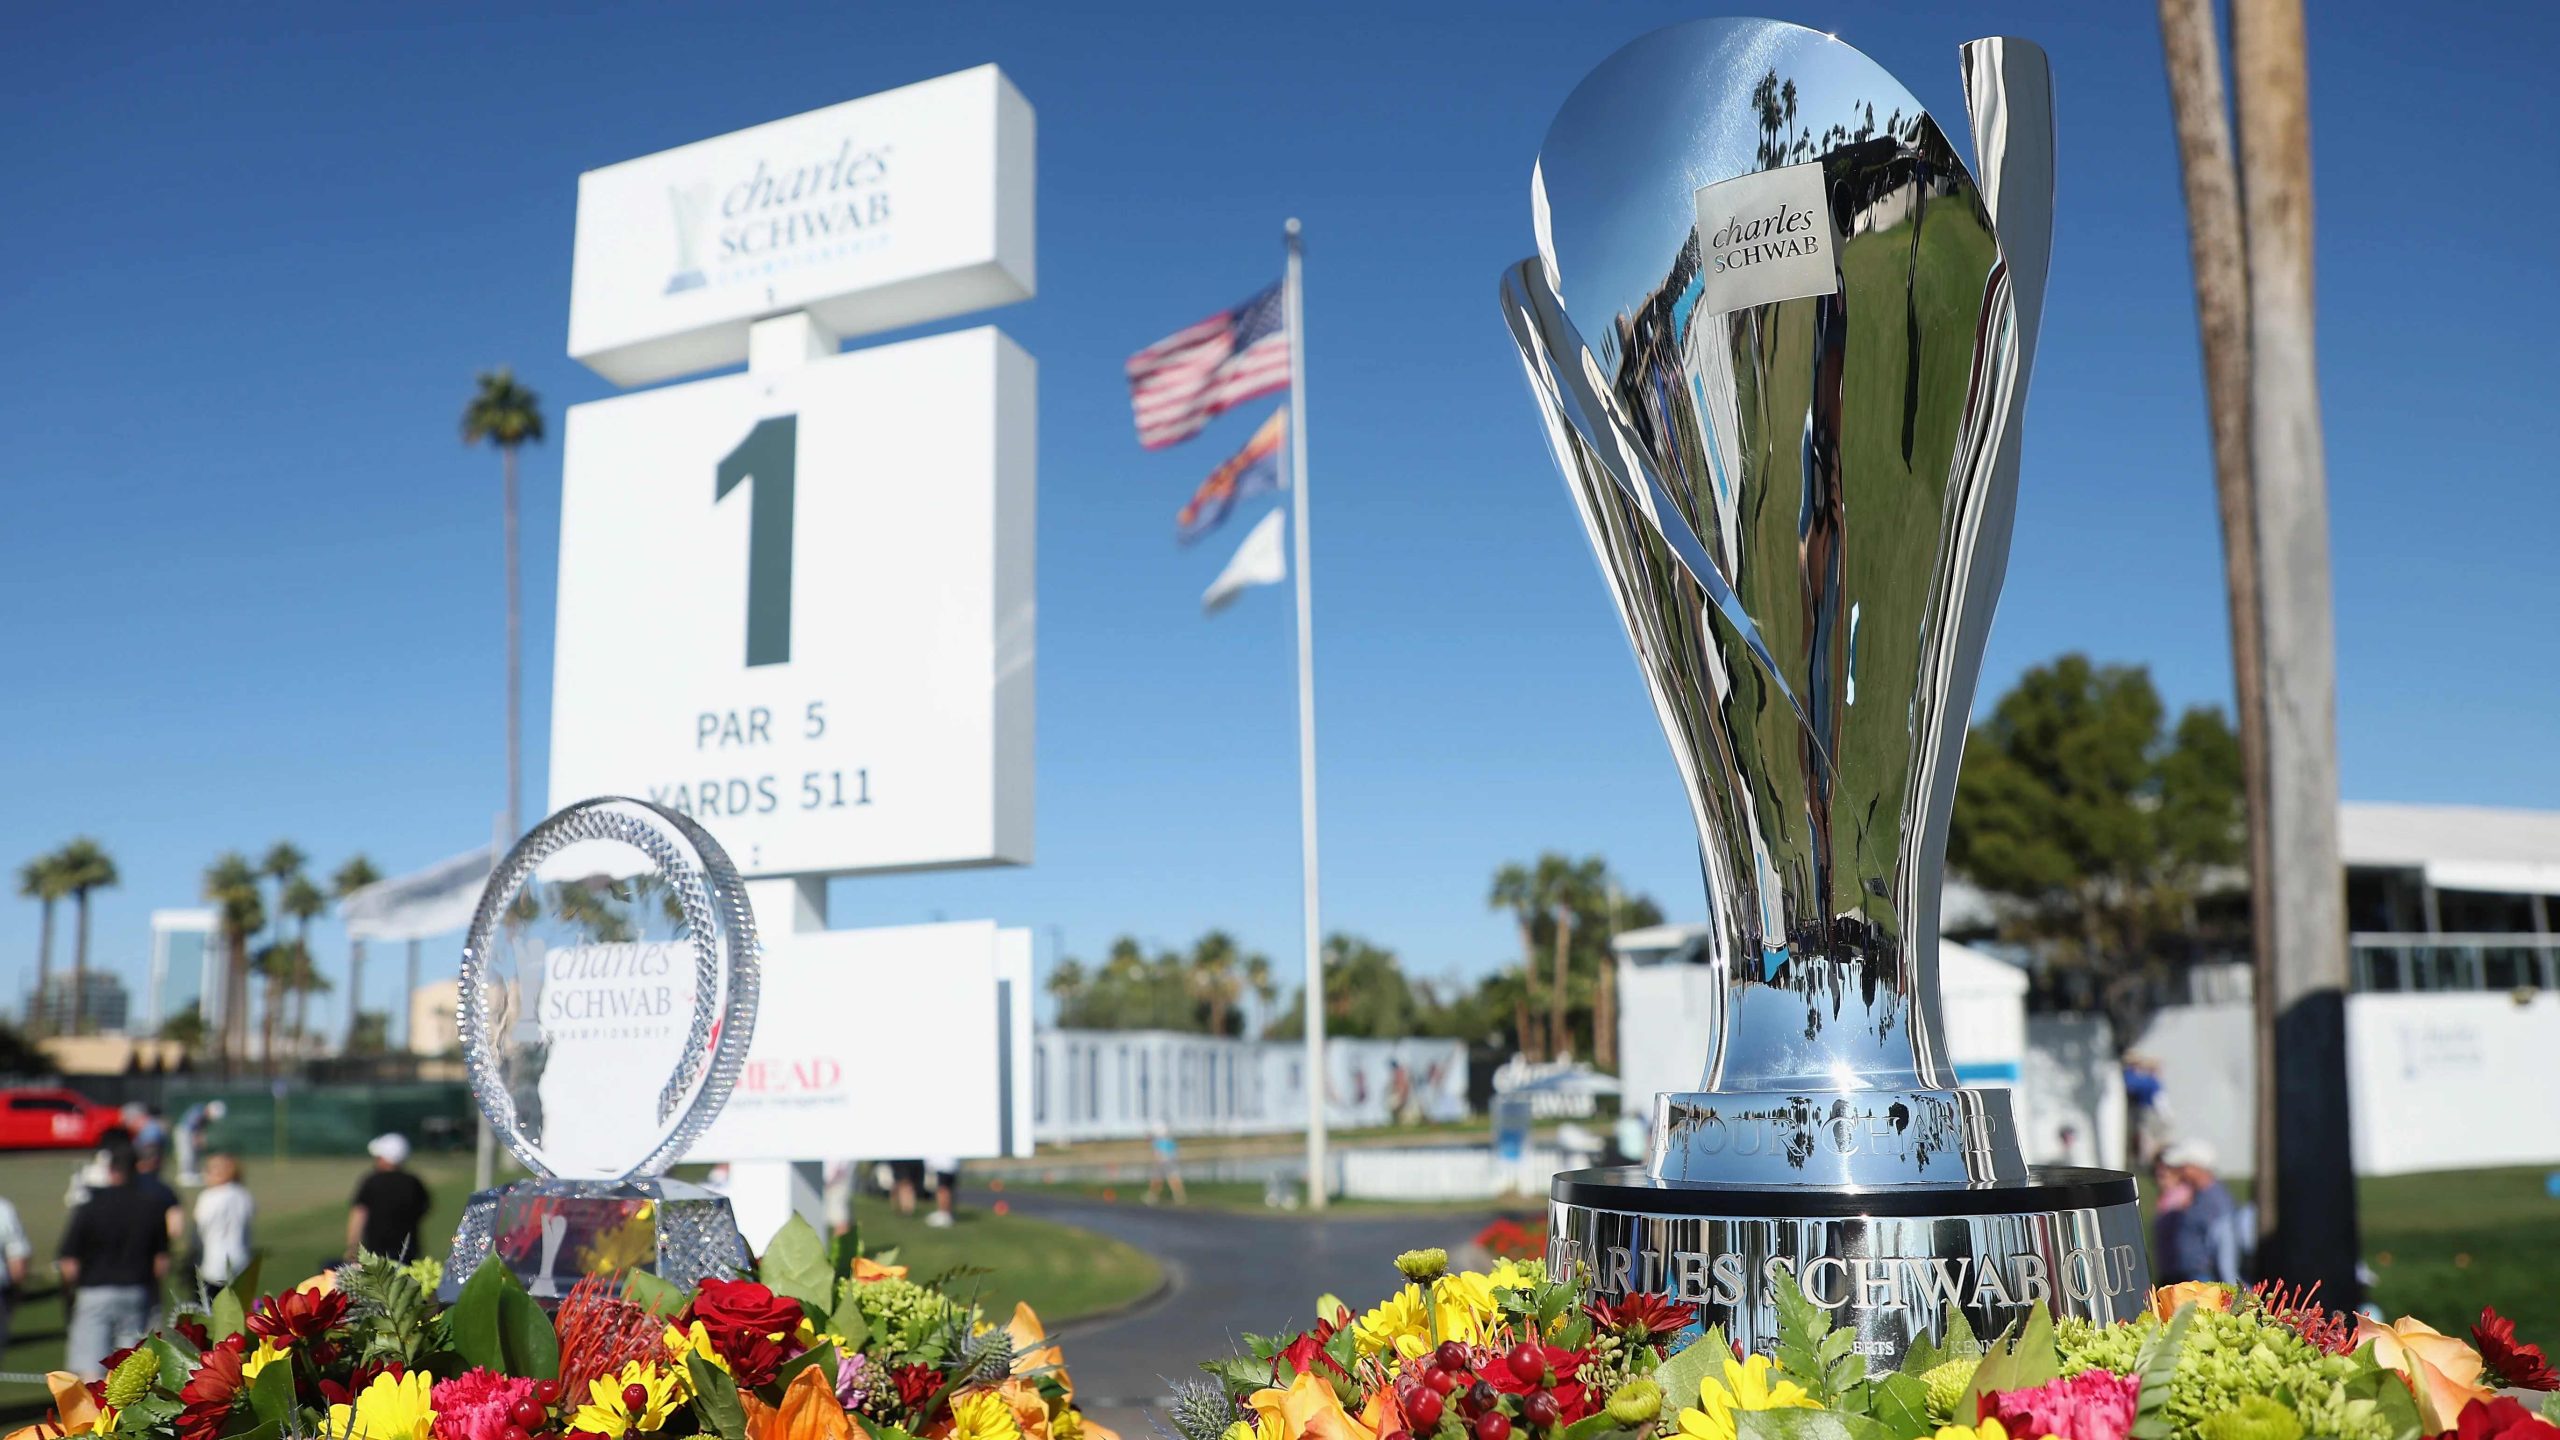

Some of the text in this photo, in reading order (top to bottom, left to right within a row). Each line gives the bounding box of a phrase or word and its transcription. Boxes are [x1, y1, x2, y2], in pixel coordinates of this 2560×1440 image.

[721, 137, 887, 220] charles
[718, 192, 891, 260] SCHWAB
[1713, 203, 1814, 249] charles
[1714, 236, 1819, 274] SCHWAB
[710, 412, 798, 669] 1
[696, 700, 826, 750] PAR 5
[801, 768, 872, 811] 511
[552, 929, 670, 981] charles
[549, 985, 673, 1020] SCHWAB
[1679, 1114, 1808, 1157] TOUR
[1762, 1252, 2051, 1310] SCHWAB
[2060, 1244, 2137, 1302] CUP
[1852, 1340, 1896, 1356] ERTS
